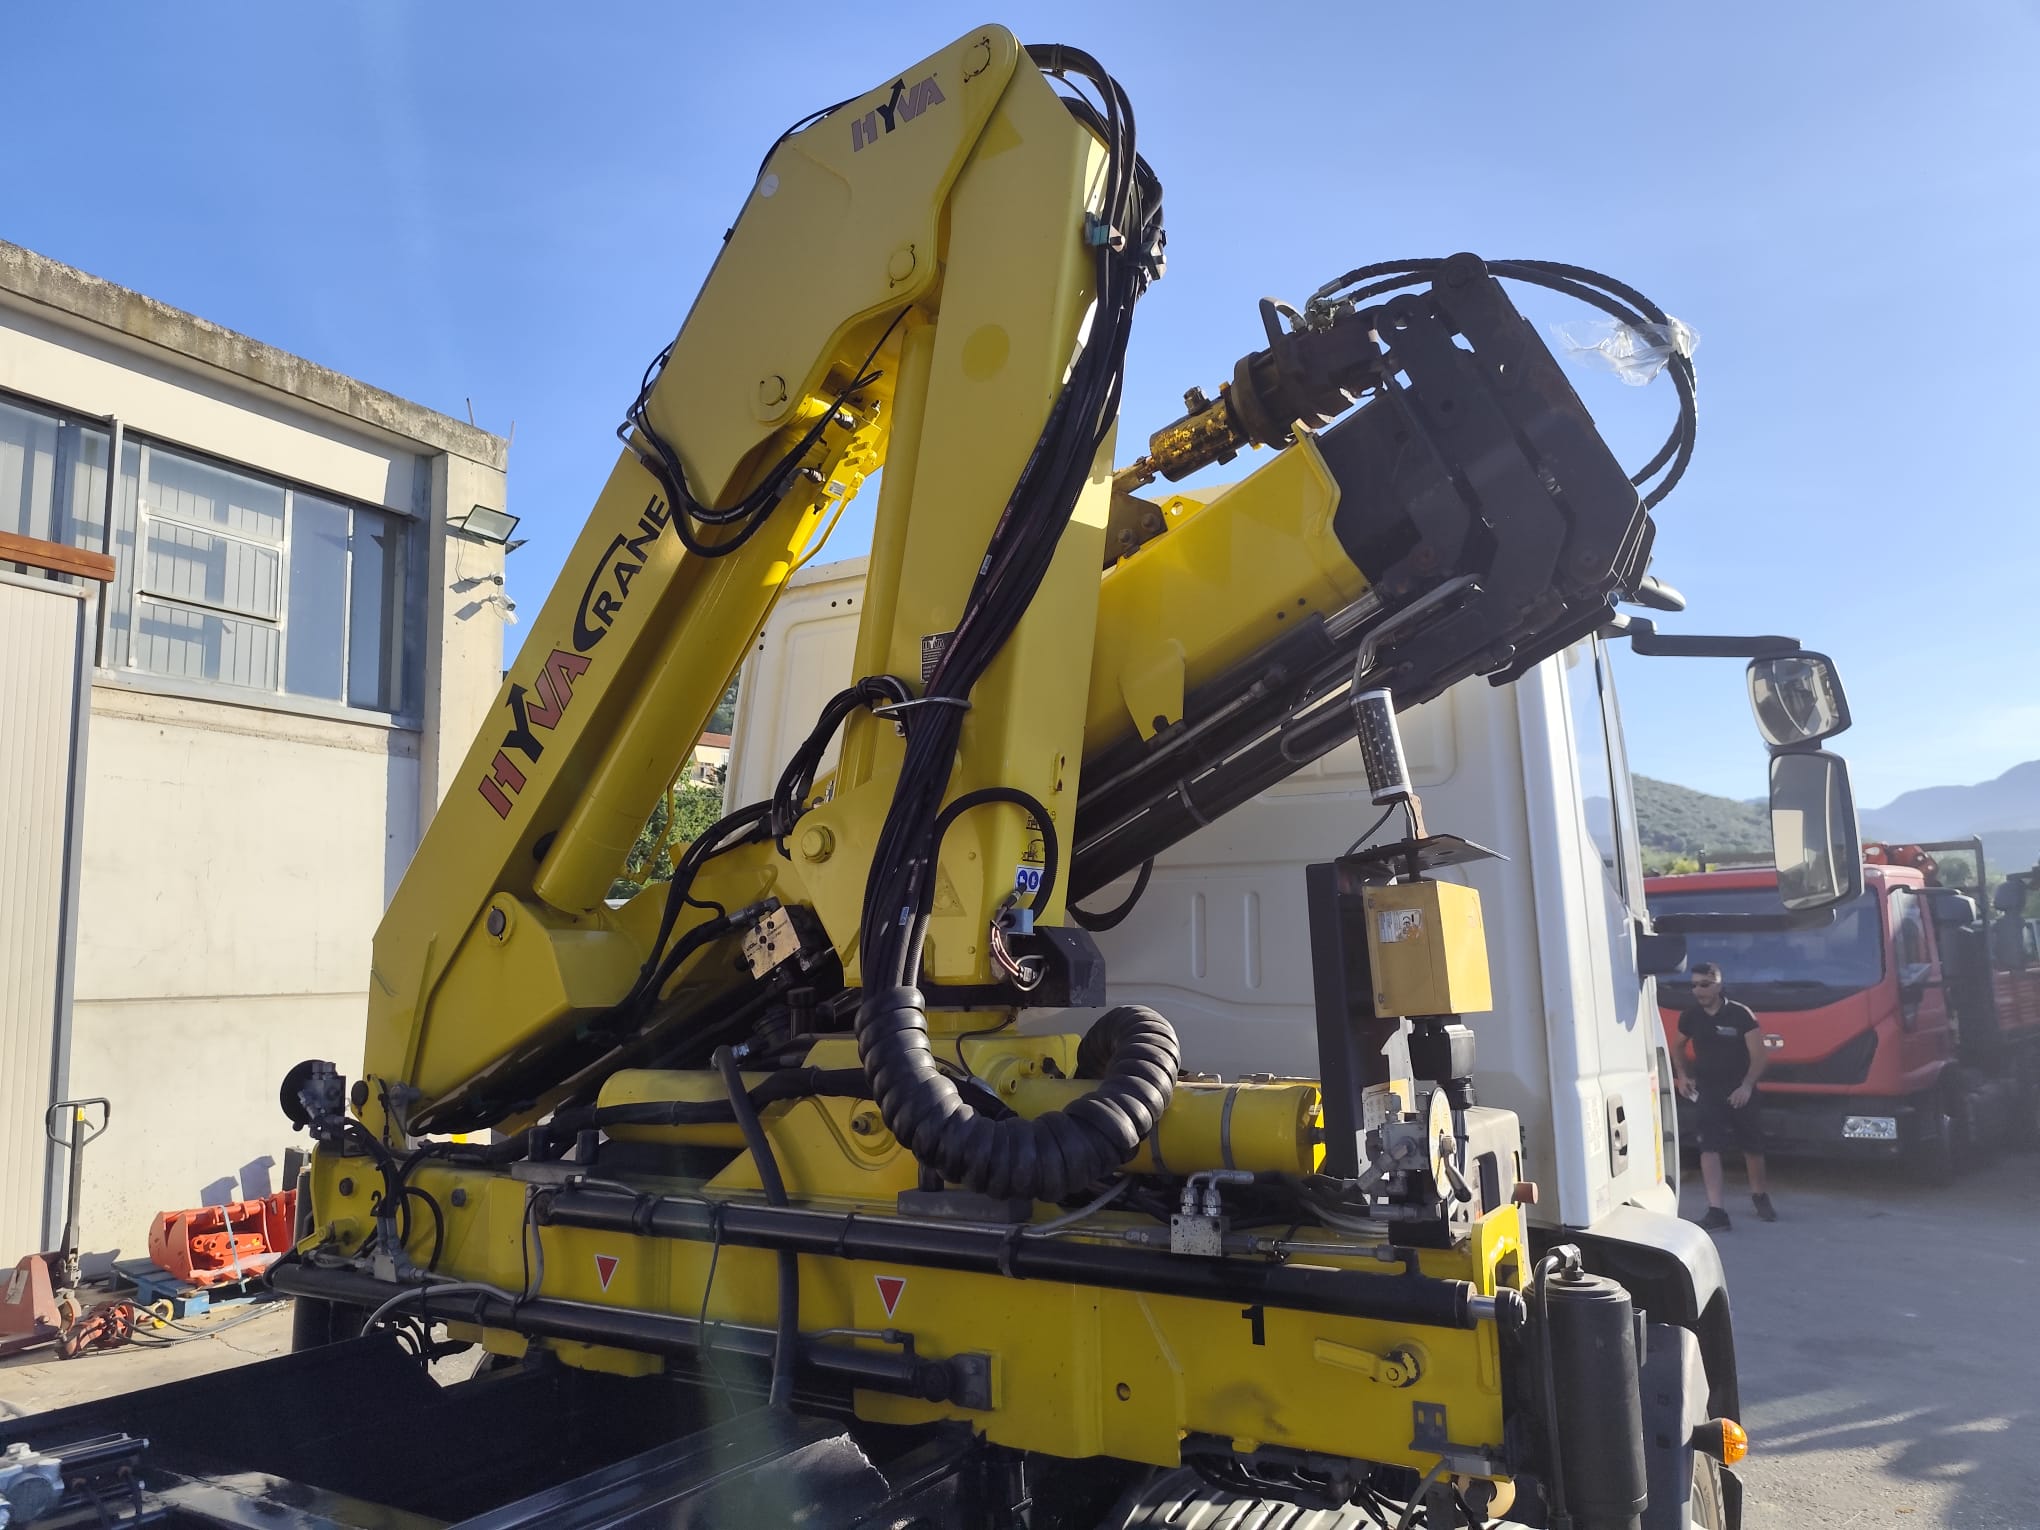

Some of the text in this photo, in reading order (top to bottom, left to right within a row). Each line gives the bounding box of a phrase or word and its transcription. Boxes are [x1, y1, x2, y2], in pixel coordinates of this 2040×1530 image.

[851, 77, 946, 152] HYVA
[478, 494, 673, 820] HYVA CRANE
[1242, 1304, 1265, 1345] 1
